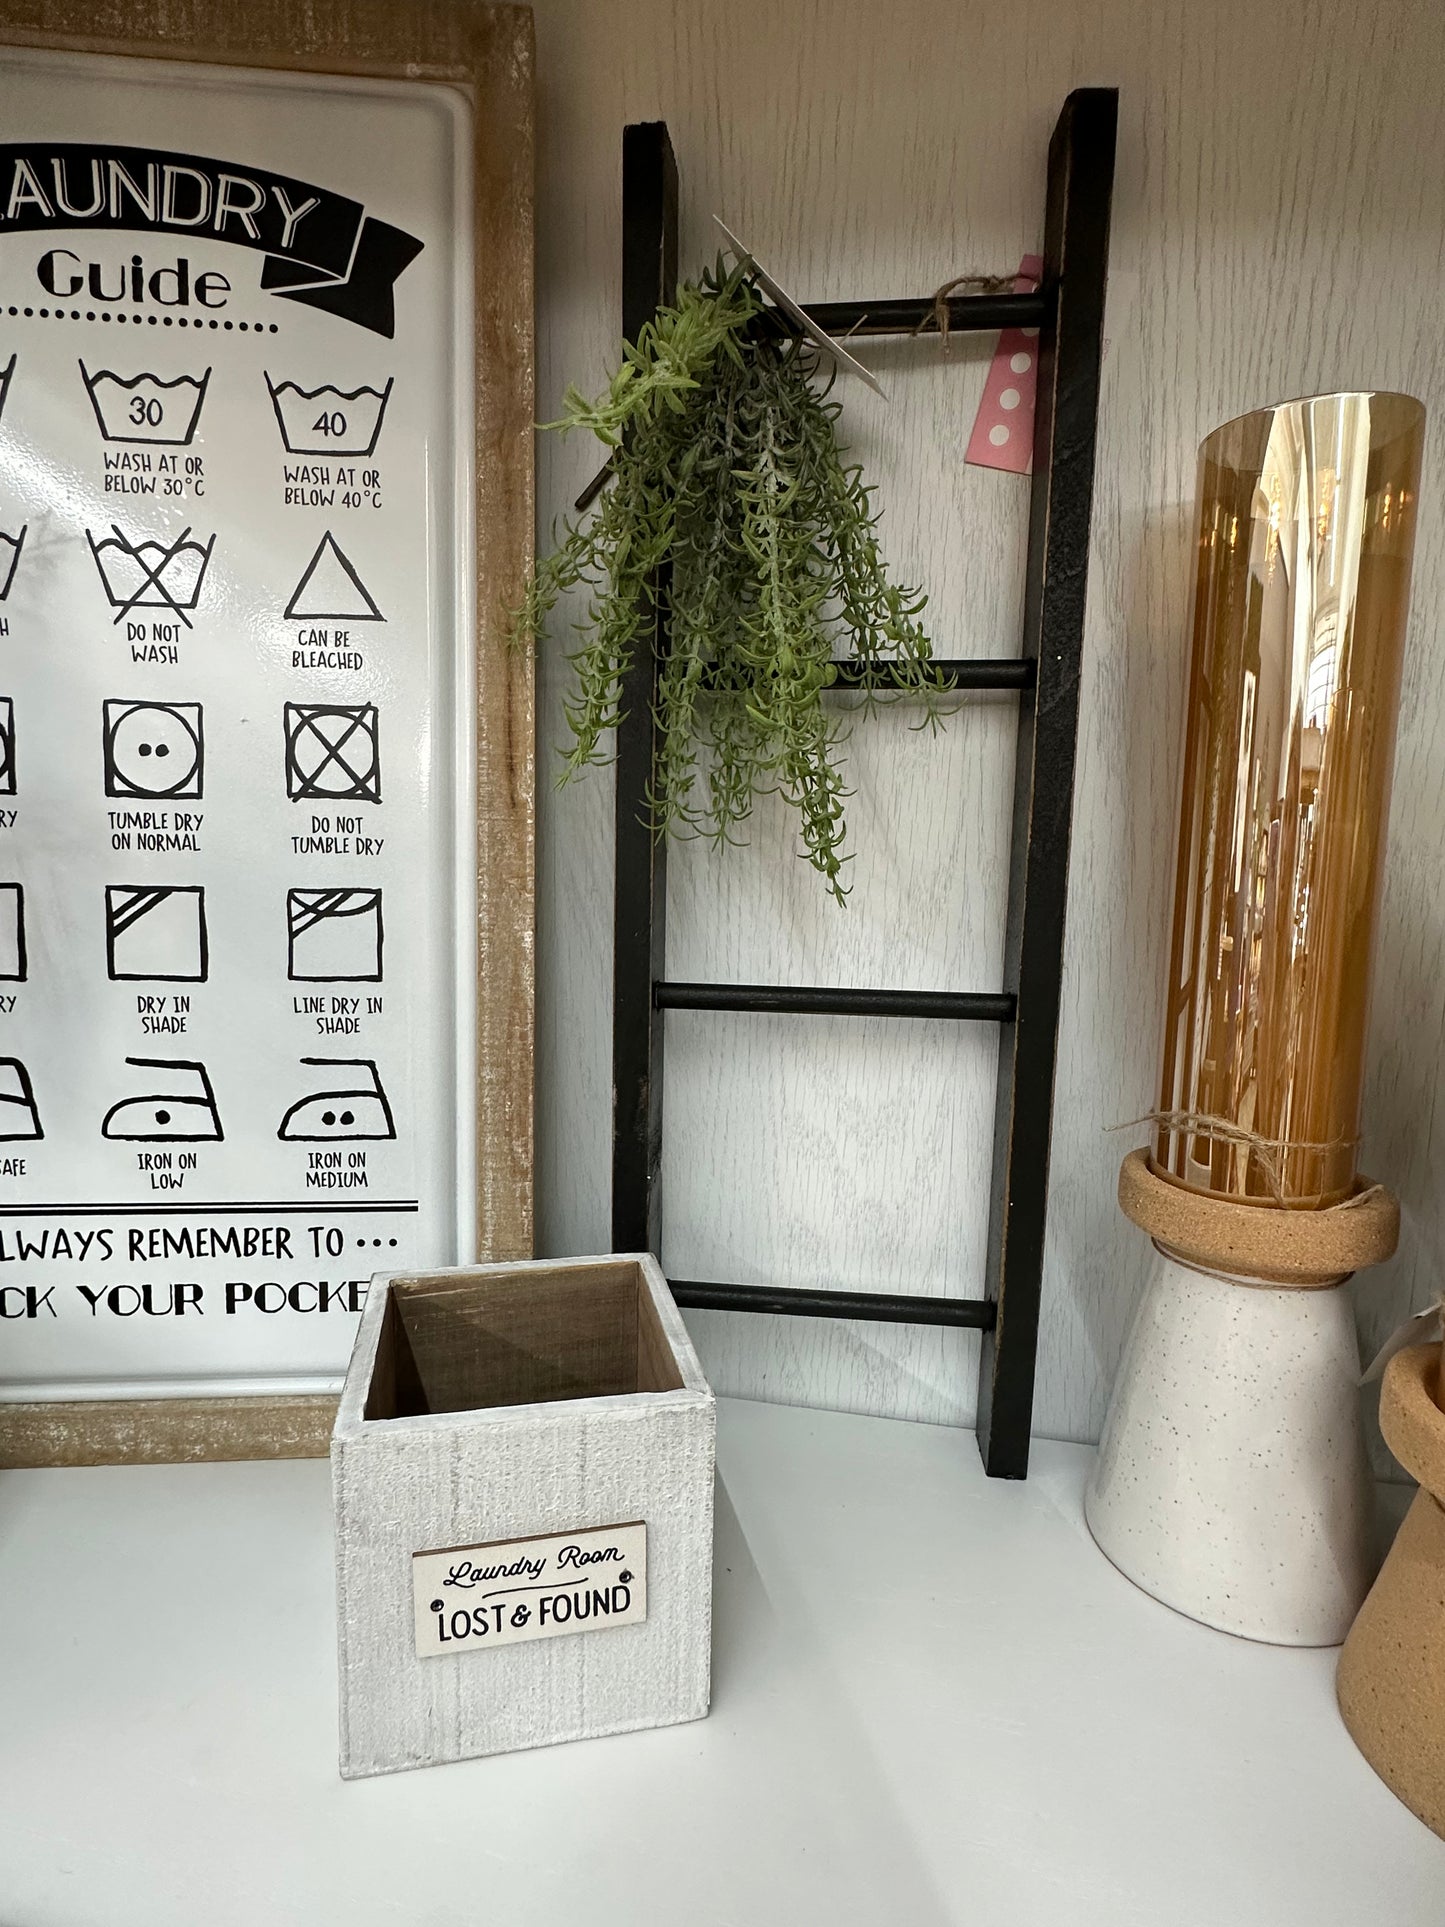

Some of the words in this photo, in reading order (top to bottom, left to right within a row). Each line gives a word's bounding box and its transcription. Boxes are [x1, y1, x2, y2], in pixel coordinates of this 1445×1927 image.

[0, 158, 320, 248] AUNDRY
[37, 249, 231, 309] Guide
[128, 395, 164, 427] 30
[311, 411, 347, 437] 40
[104, 452, 152, 473] WASH
[158, 454, 178, 474] AT
[185, 456, 204, 476] OR
[104, 475, 155, 494] BELOW
[284, 465, 330, 486] WASH
[336, 467, 356, 487] AT
[362, 469, 381, 488] OR
[284, 487, 335, 506] BELOW
[127, 622, 146, 642] DO
[152, 623, 181, 643] NOT
[298, 629, 328, 647] CAN
[334, 630, 350, 648] BE
[131, 644, 178, 665] WASH
[292, 650, 363, 671] BLEACHED
[108, 811, 169, 830] TUMBLE
[174, 812, 204, 832] DRY
[311, 815, 330, 834] DO
[336, 816, 364, 835] NOT
[111, 833, 131, 850] ON
[137, 833, 201, 852] NORMAL
[291, 836, 350, 854] TUMBLE
[355, 837, 385, 856] DRY
[137, 995, 167, 1014] DRY
[172, 995, 190, 1013] IN
[293, 996, 326, 1014] LINE
[331, 996, 360, 1015] DRY
[366, 997, 383, 1014] IN
[141, 1015, 187, 1034] SHADE
[316, 1016, 361, 1035] SHADE
[0, 1158, 27, 1177] AFE
[137, 1152, 172, 1171] IRON
[178, 1152, 197, 1170] ON
[307, 1151, 342, 1170] IRON
[348, 1151, 366, 1169] ON
[150, 1173, 184, 1190] LOW
[306, 1172, 369, 1189] MEDIUM
[128, 1226, 294, 1262] REMEMBER
[75, 1284, 205, 1318] YOUR
[443, 1556, 547, 1588] Laundry
[556, 1545, 626, 1569] Room
[438, 1603, 506, 1642] LOST
[510, 1603, 532, 1628] &
[539, 1584, 631, 1626] FOUND
